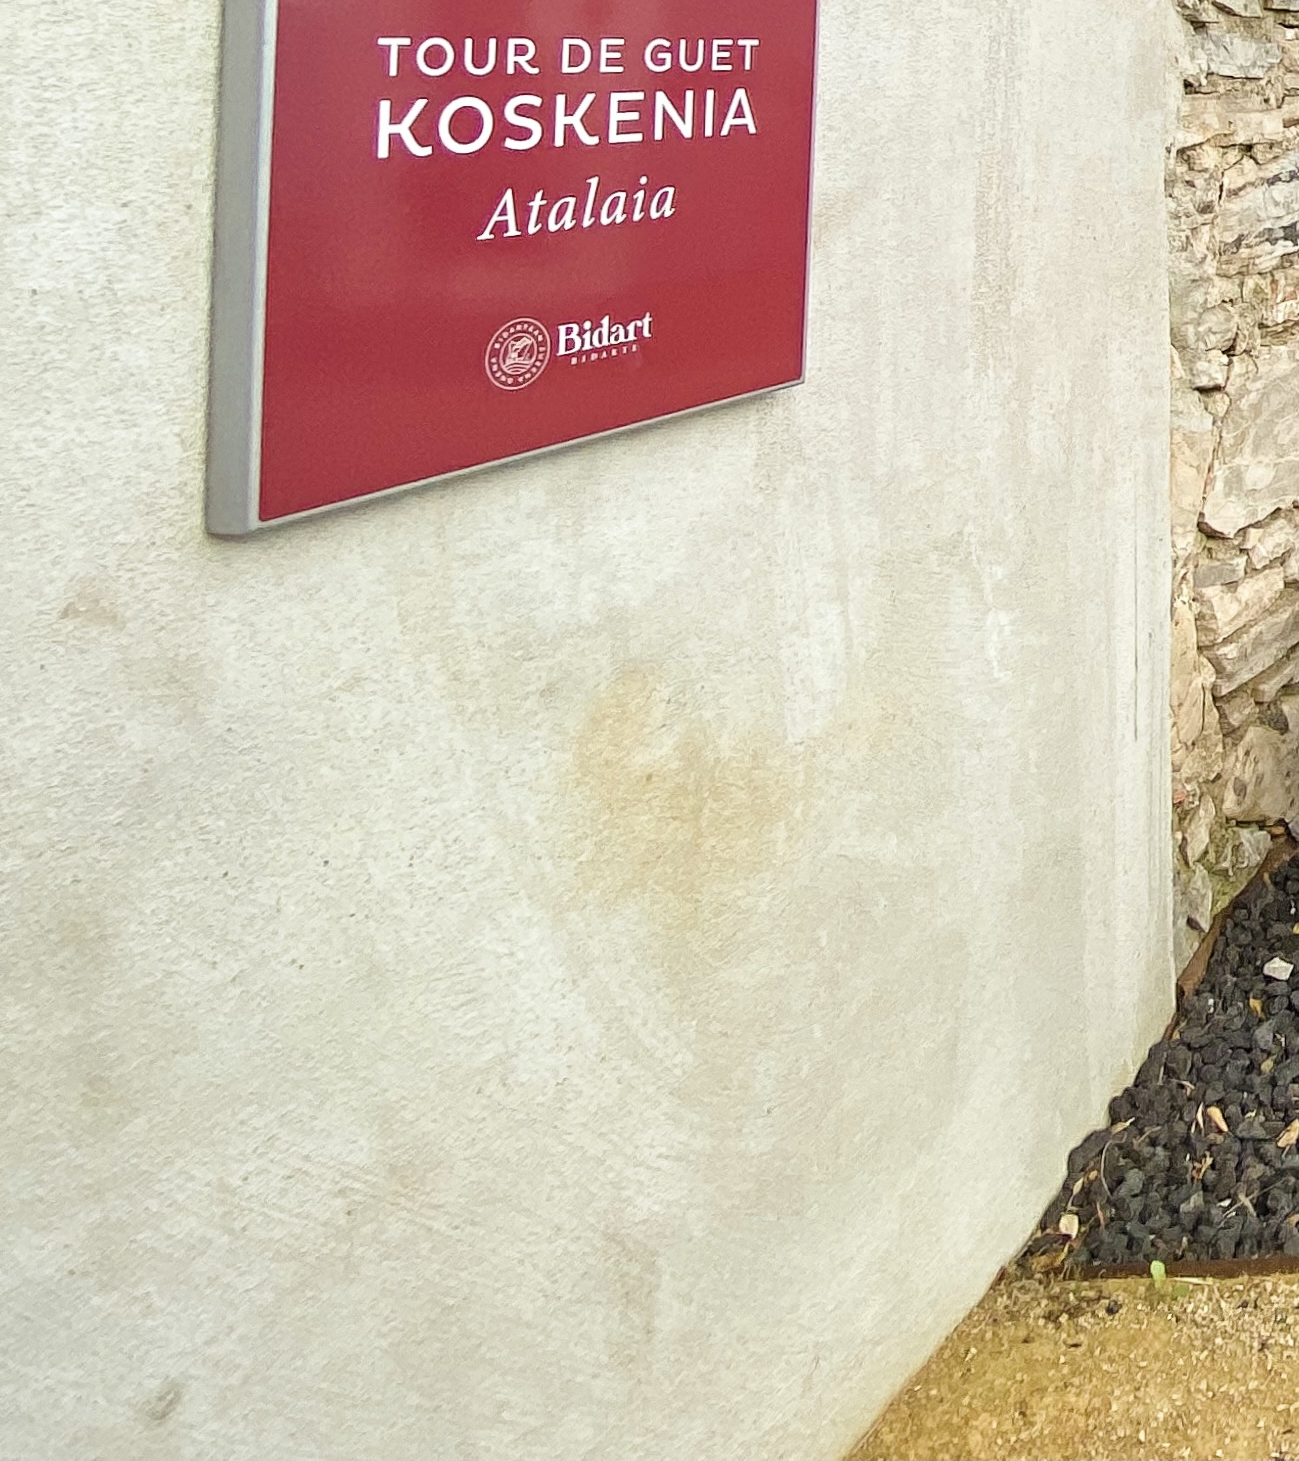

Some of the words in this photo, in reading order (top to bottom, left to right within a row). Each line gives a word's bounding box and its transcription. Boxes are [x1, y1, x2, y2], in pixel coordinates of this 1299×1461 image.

[377, 37, 540, 77] TOUR
[561, 38, 625, 74] DE
[644, 38, 760, 73] GUET
[377, 88, 757, 159] KOSKENIA
[477, 176, 676, 241] Atalaia
[556, 312, 653, 356] Bidart
